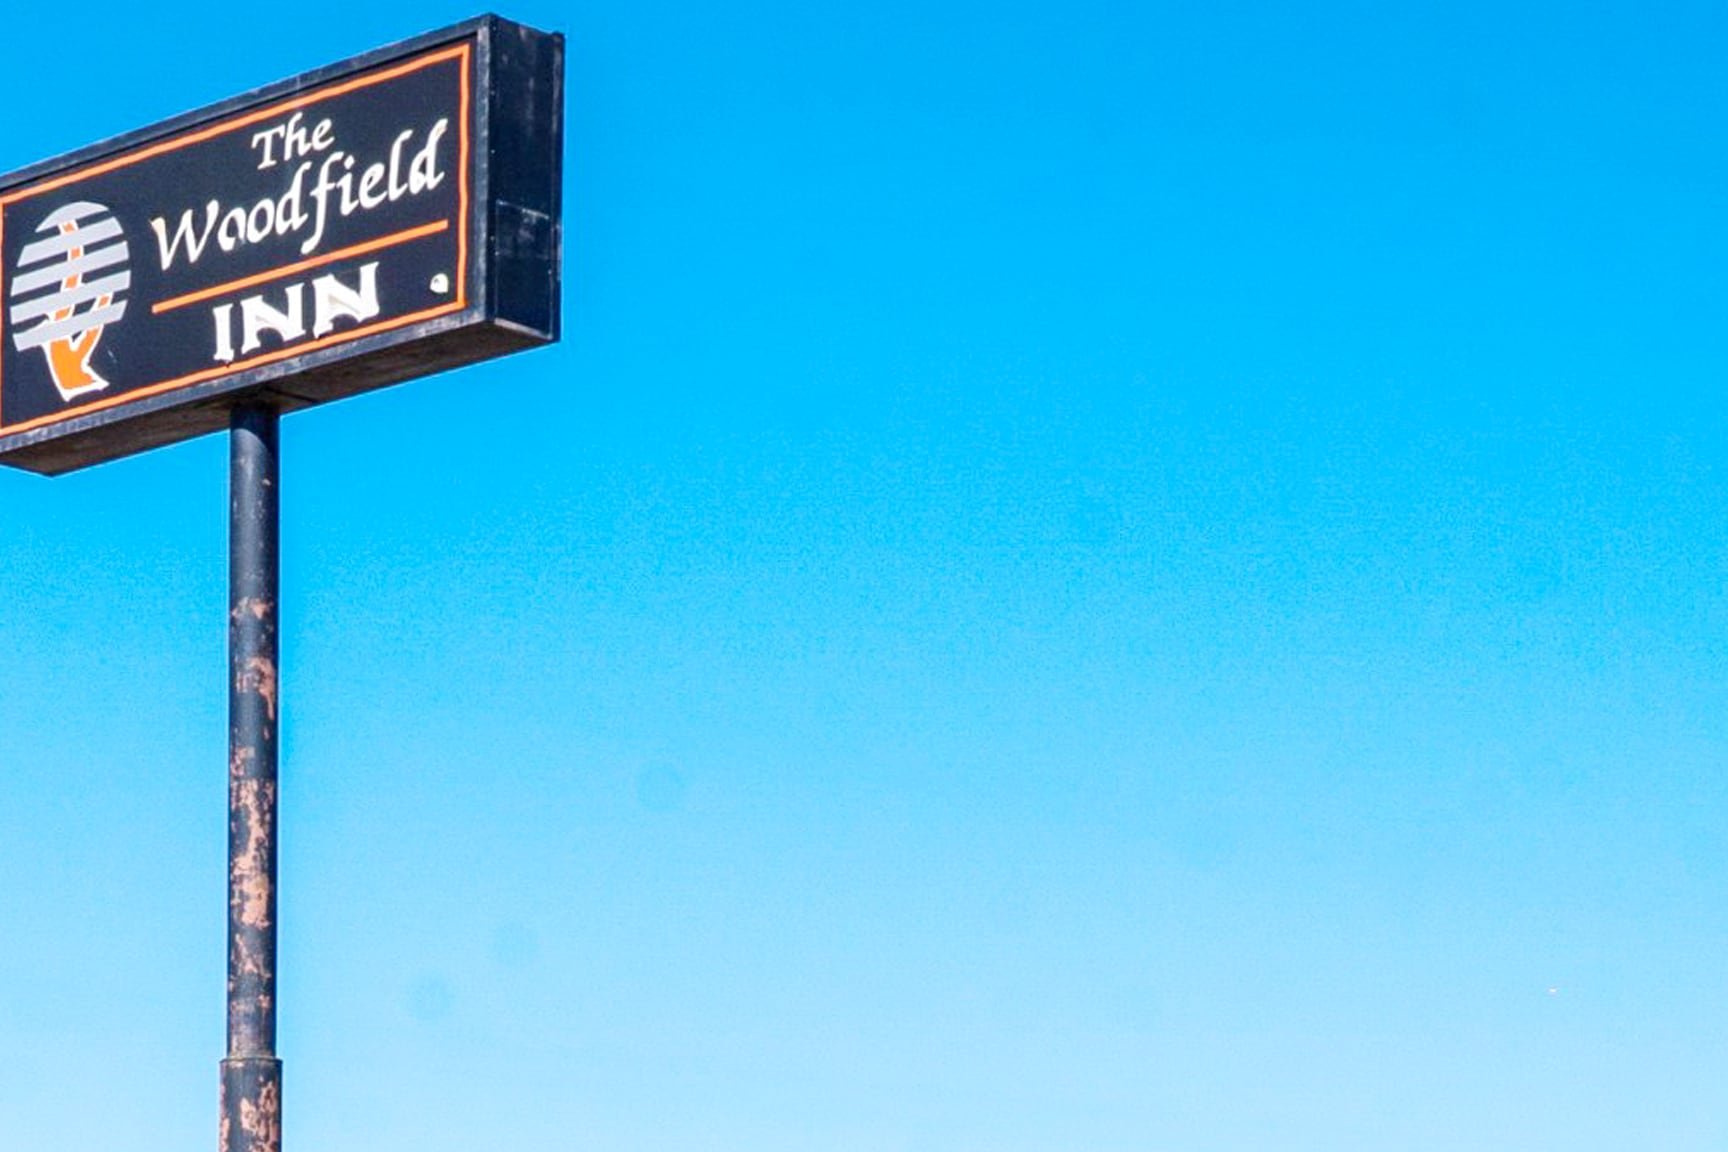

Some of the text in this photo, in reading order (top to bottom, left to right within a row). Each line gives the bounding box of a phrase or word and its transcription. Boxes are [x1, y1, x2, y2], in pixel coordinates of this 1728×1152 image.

[251, 112, 335, 170] The
[151, 118, 449, 271] Woodfield
[212, 262, 380, 362] INN
